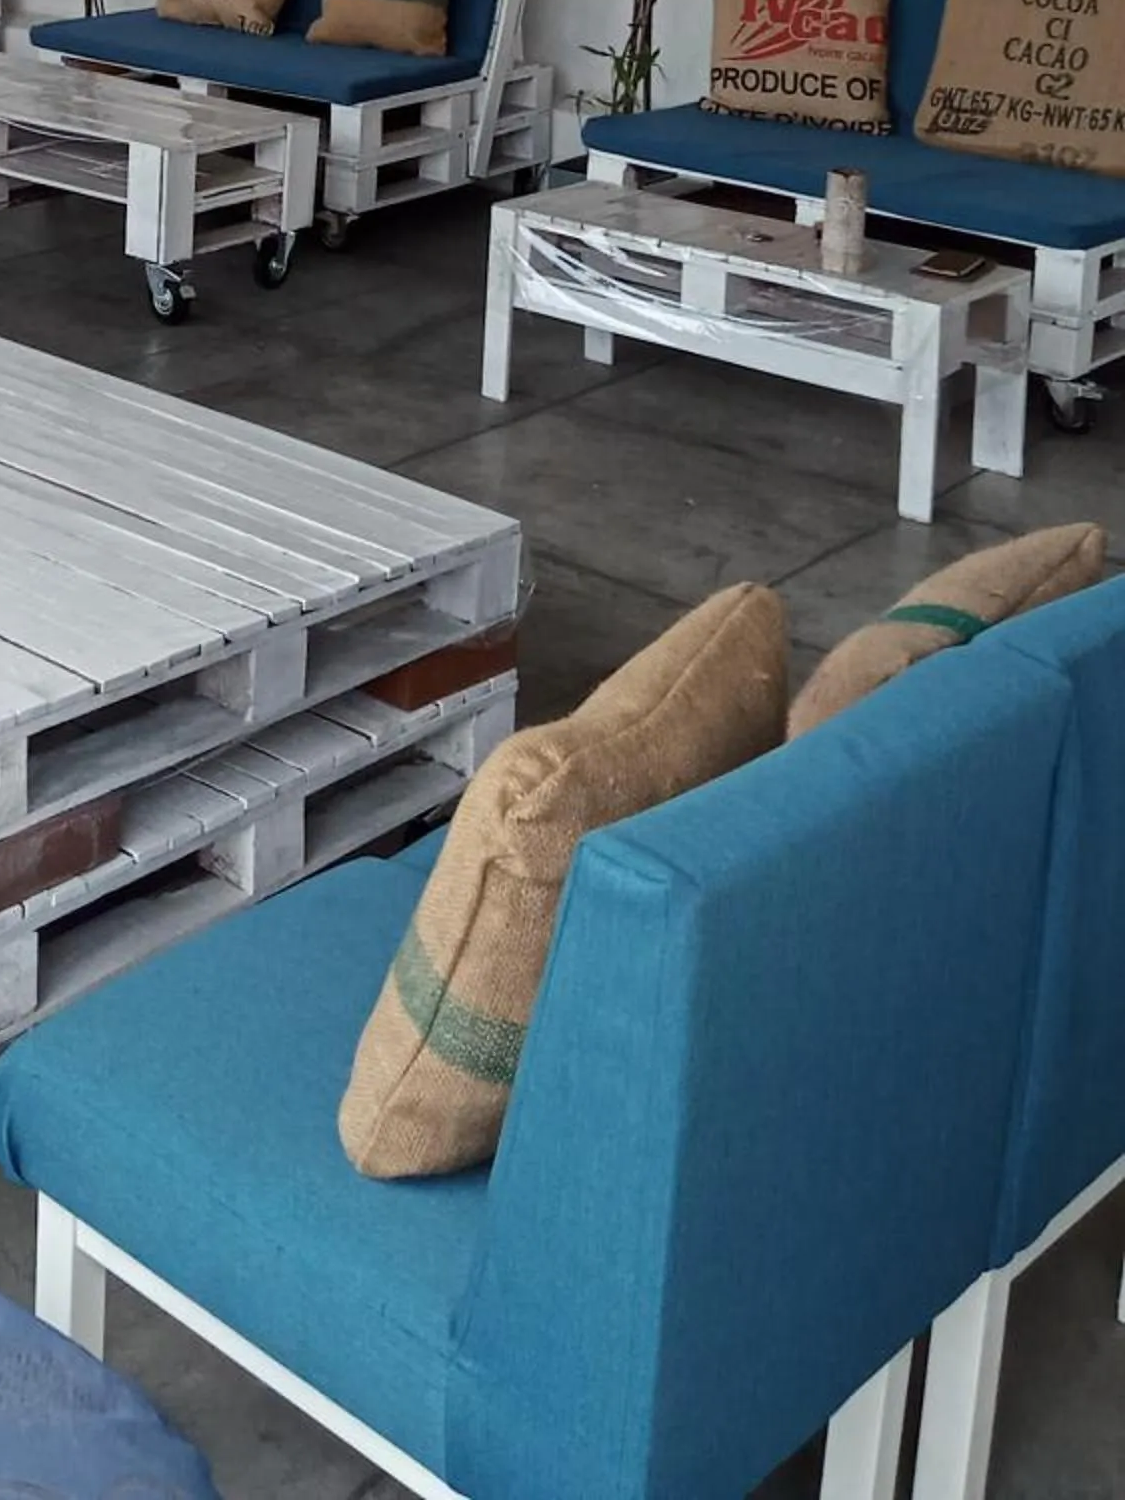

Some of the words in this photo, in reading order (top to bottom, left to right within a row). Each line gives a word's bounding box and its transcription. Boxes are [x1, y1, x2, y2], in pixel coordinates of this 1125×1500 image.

[1046, 17, 1074, 41] CI
[1003, 37, 1089, 71] CACAO
[711, 67, 838, 98] PRODUCE
[846, 77, 883, 101] OF
[1036, 73, 1075, 100] G2
